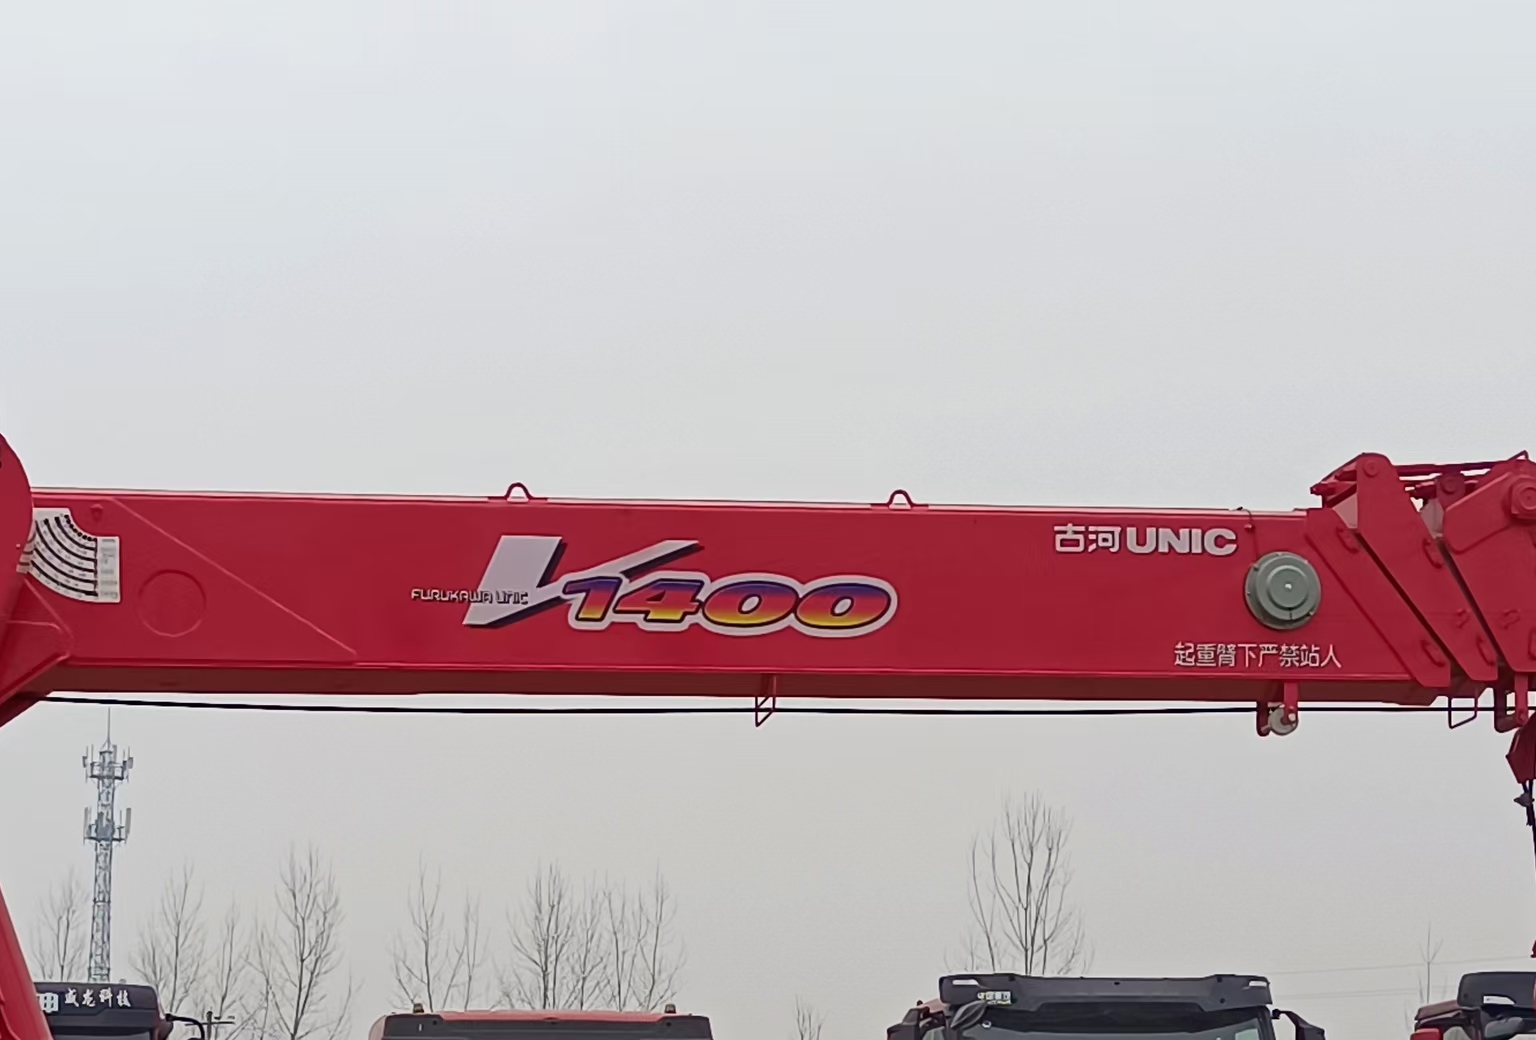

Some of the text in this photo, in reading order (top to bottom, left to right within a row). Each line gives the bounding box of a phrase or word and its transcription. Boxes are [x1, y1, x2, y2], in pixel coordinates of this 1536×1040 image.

[1053, 523, 1238, 556] 古河 UNIC
[1174, 641, 1342, 669] 起重臂下严禁站人
